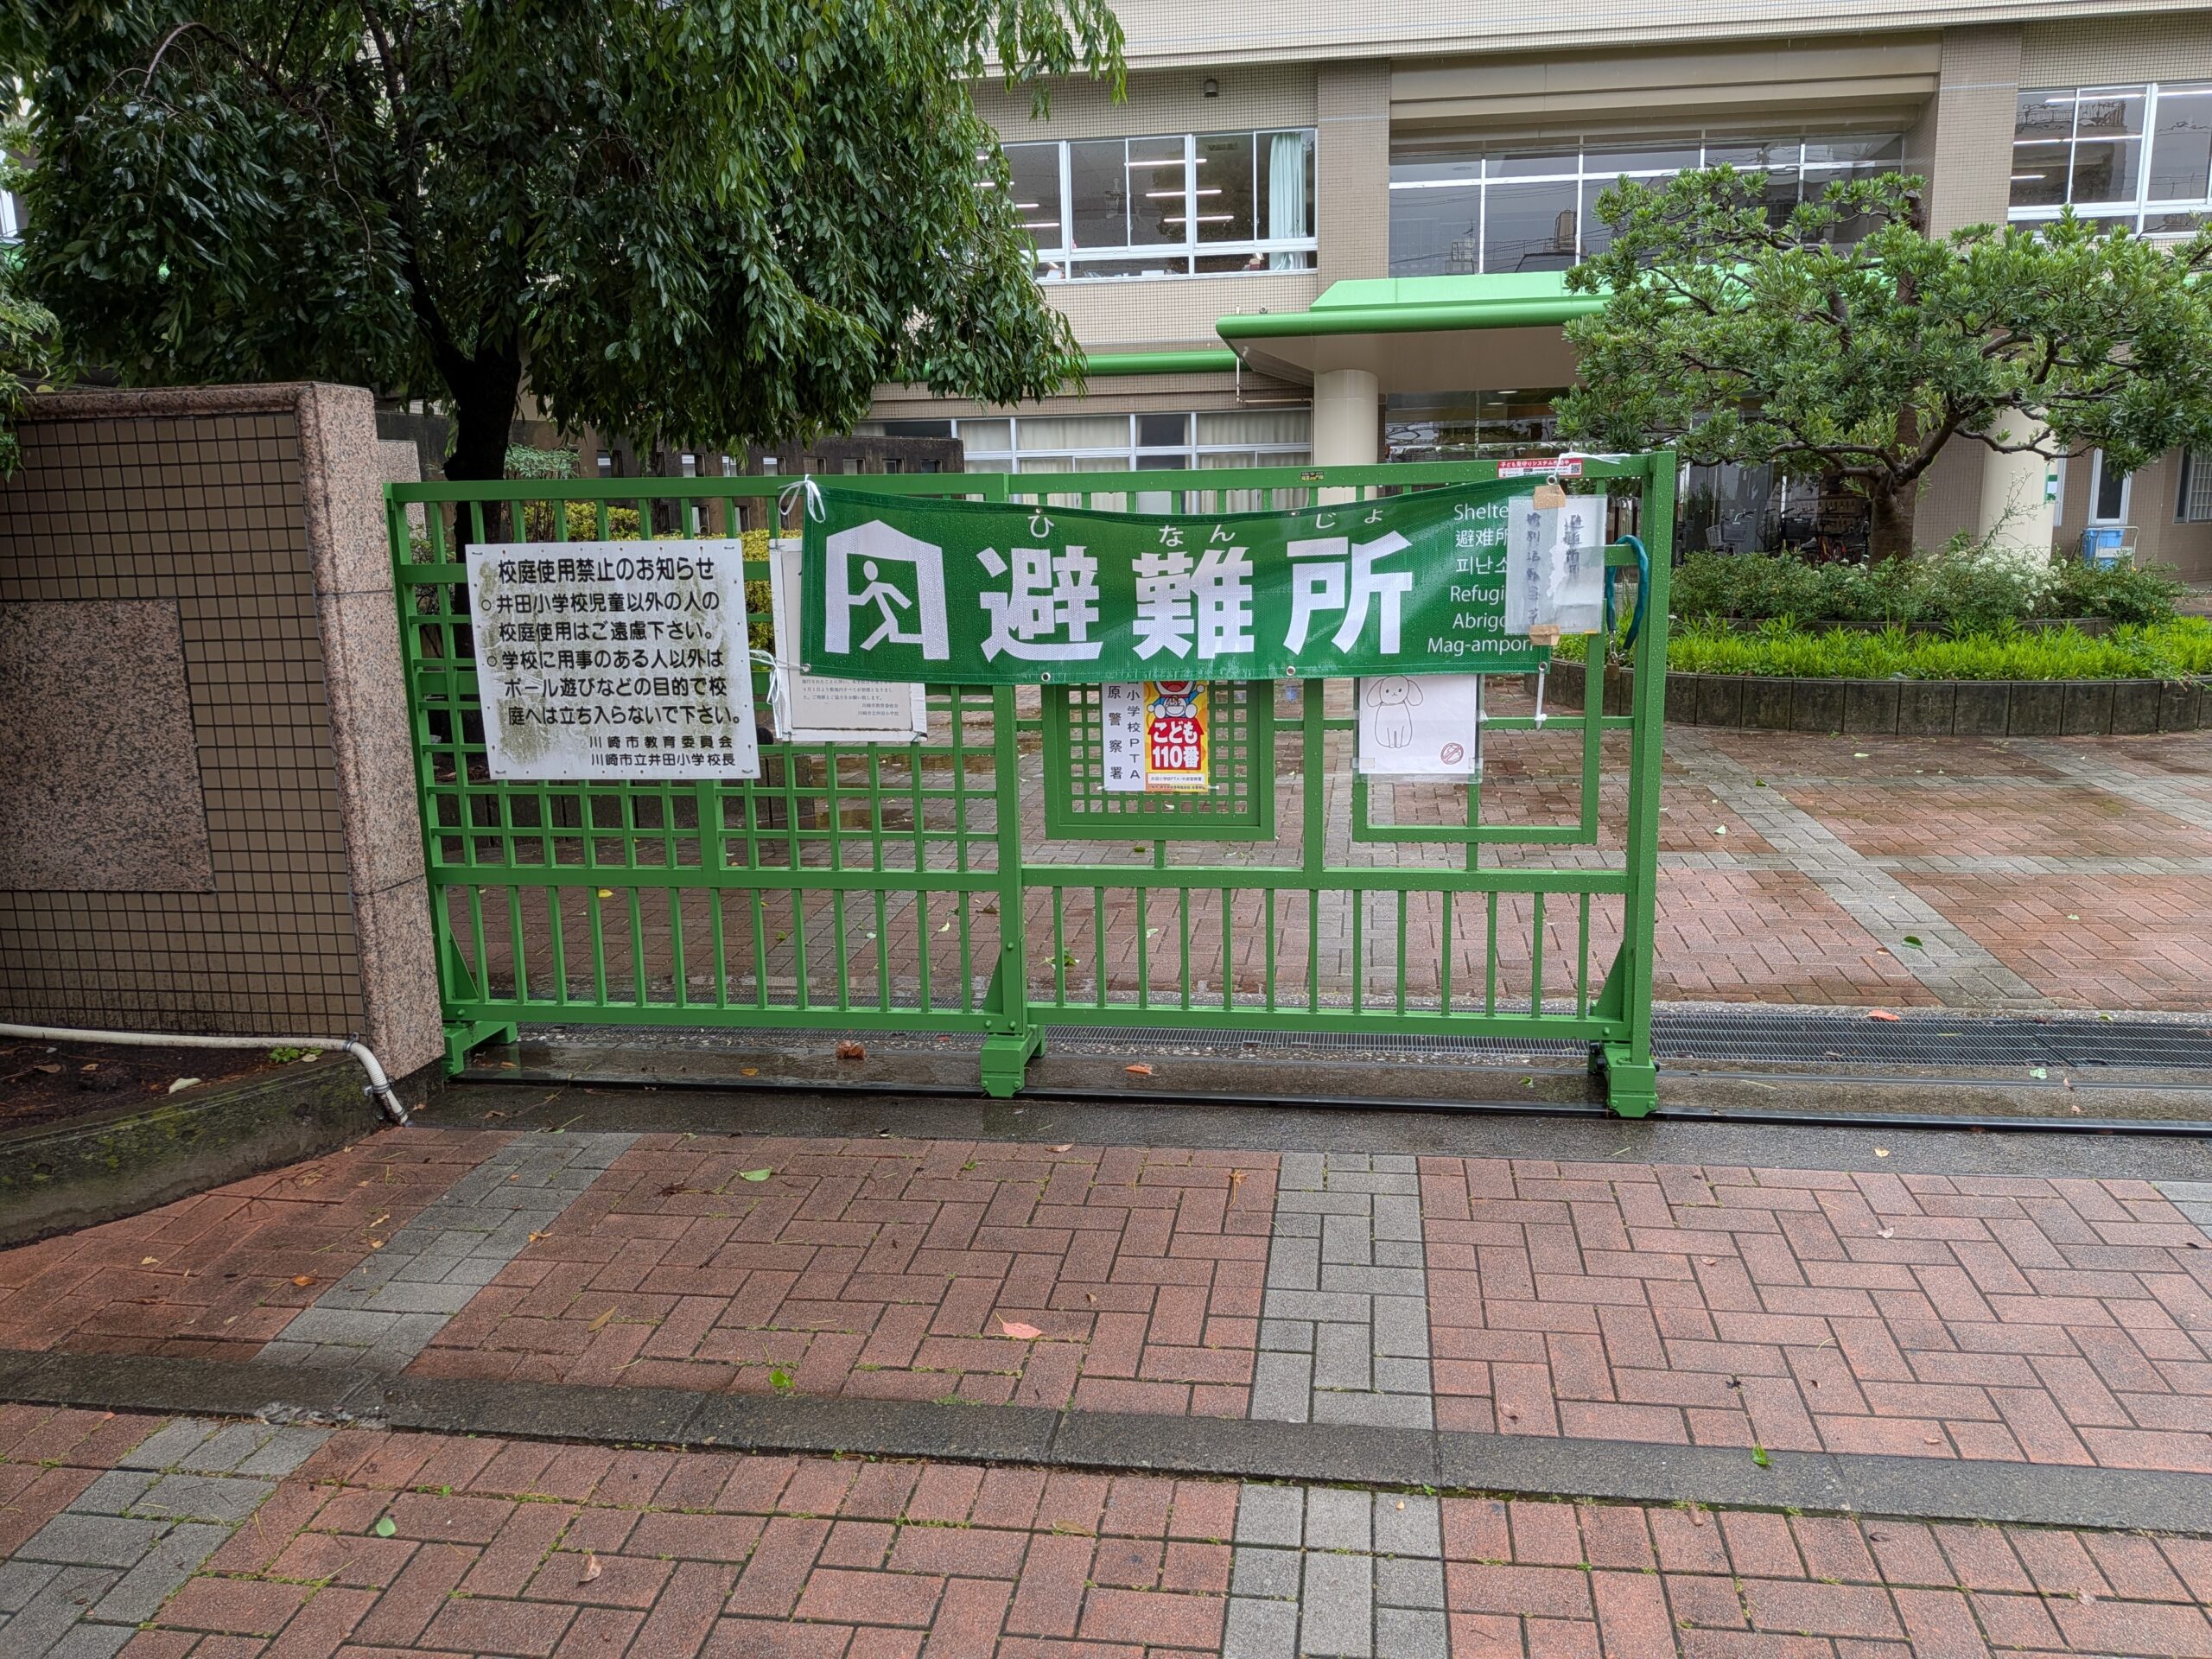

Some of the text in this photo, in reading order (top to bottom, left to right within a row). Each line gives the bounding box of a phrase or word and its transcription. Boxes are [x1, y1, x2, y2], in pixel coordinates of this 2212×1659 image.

[1453, 502, 1509, 521] Shelte
[498, 556, 715, 583] 校庭使用禁止のお知らせ
[975, 531, 1413, 662] 避難所
[1450, 584, 1505, 606] Refugi
[499, 620, 714, 642] 校庭使用はご遠慮下さい。
[505, 676, 728, 698] ボール遊びなどの目的で校
[509, 704, 741, 725] 庭へは立ち入らないで下さい。
[1108, 686, 1123, 779] 原警察署
[1127, 682, 1141, 779] 小学校PTA
[1153, 721, 1198, 744] こども
[589, 735, 733, 749] 川崎市教育委員会
[591, 753, 736, 766] 川崎市立井田小学校長
[1153, 746, 1199, 768] 110番
